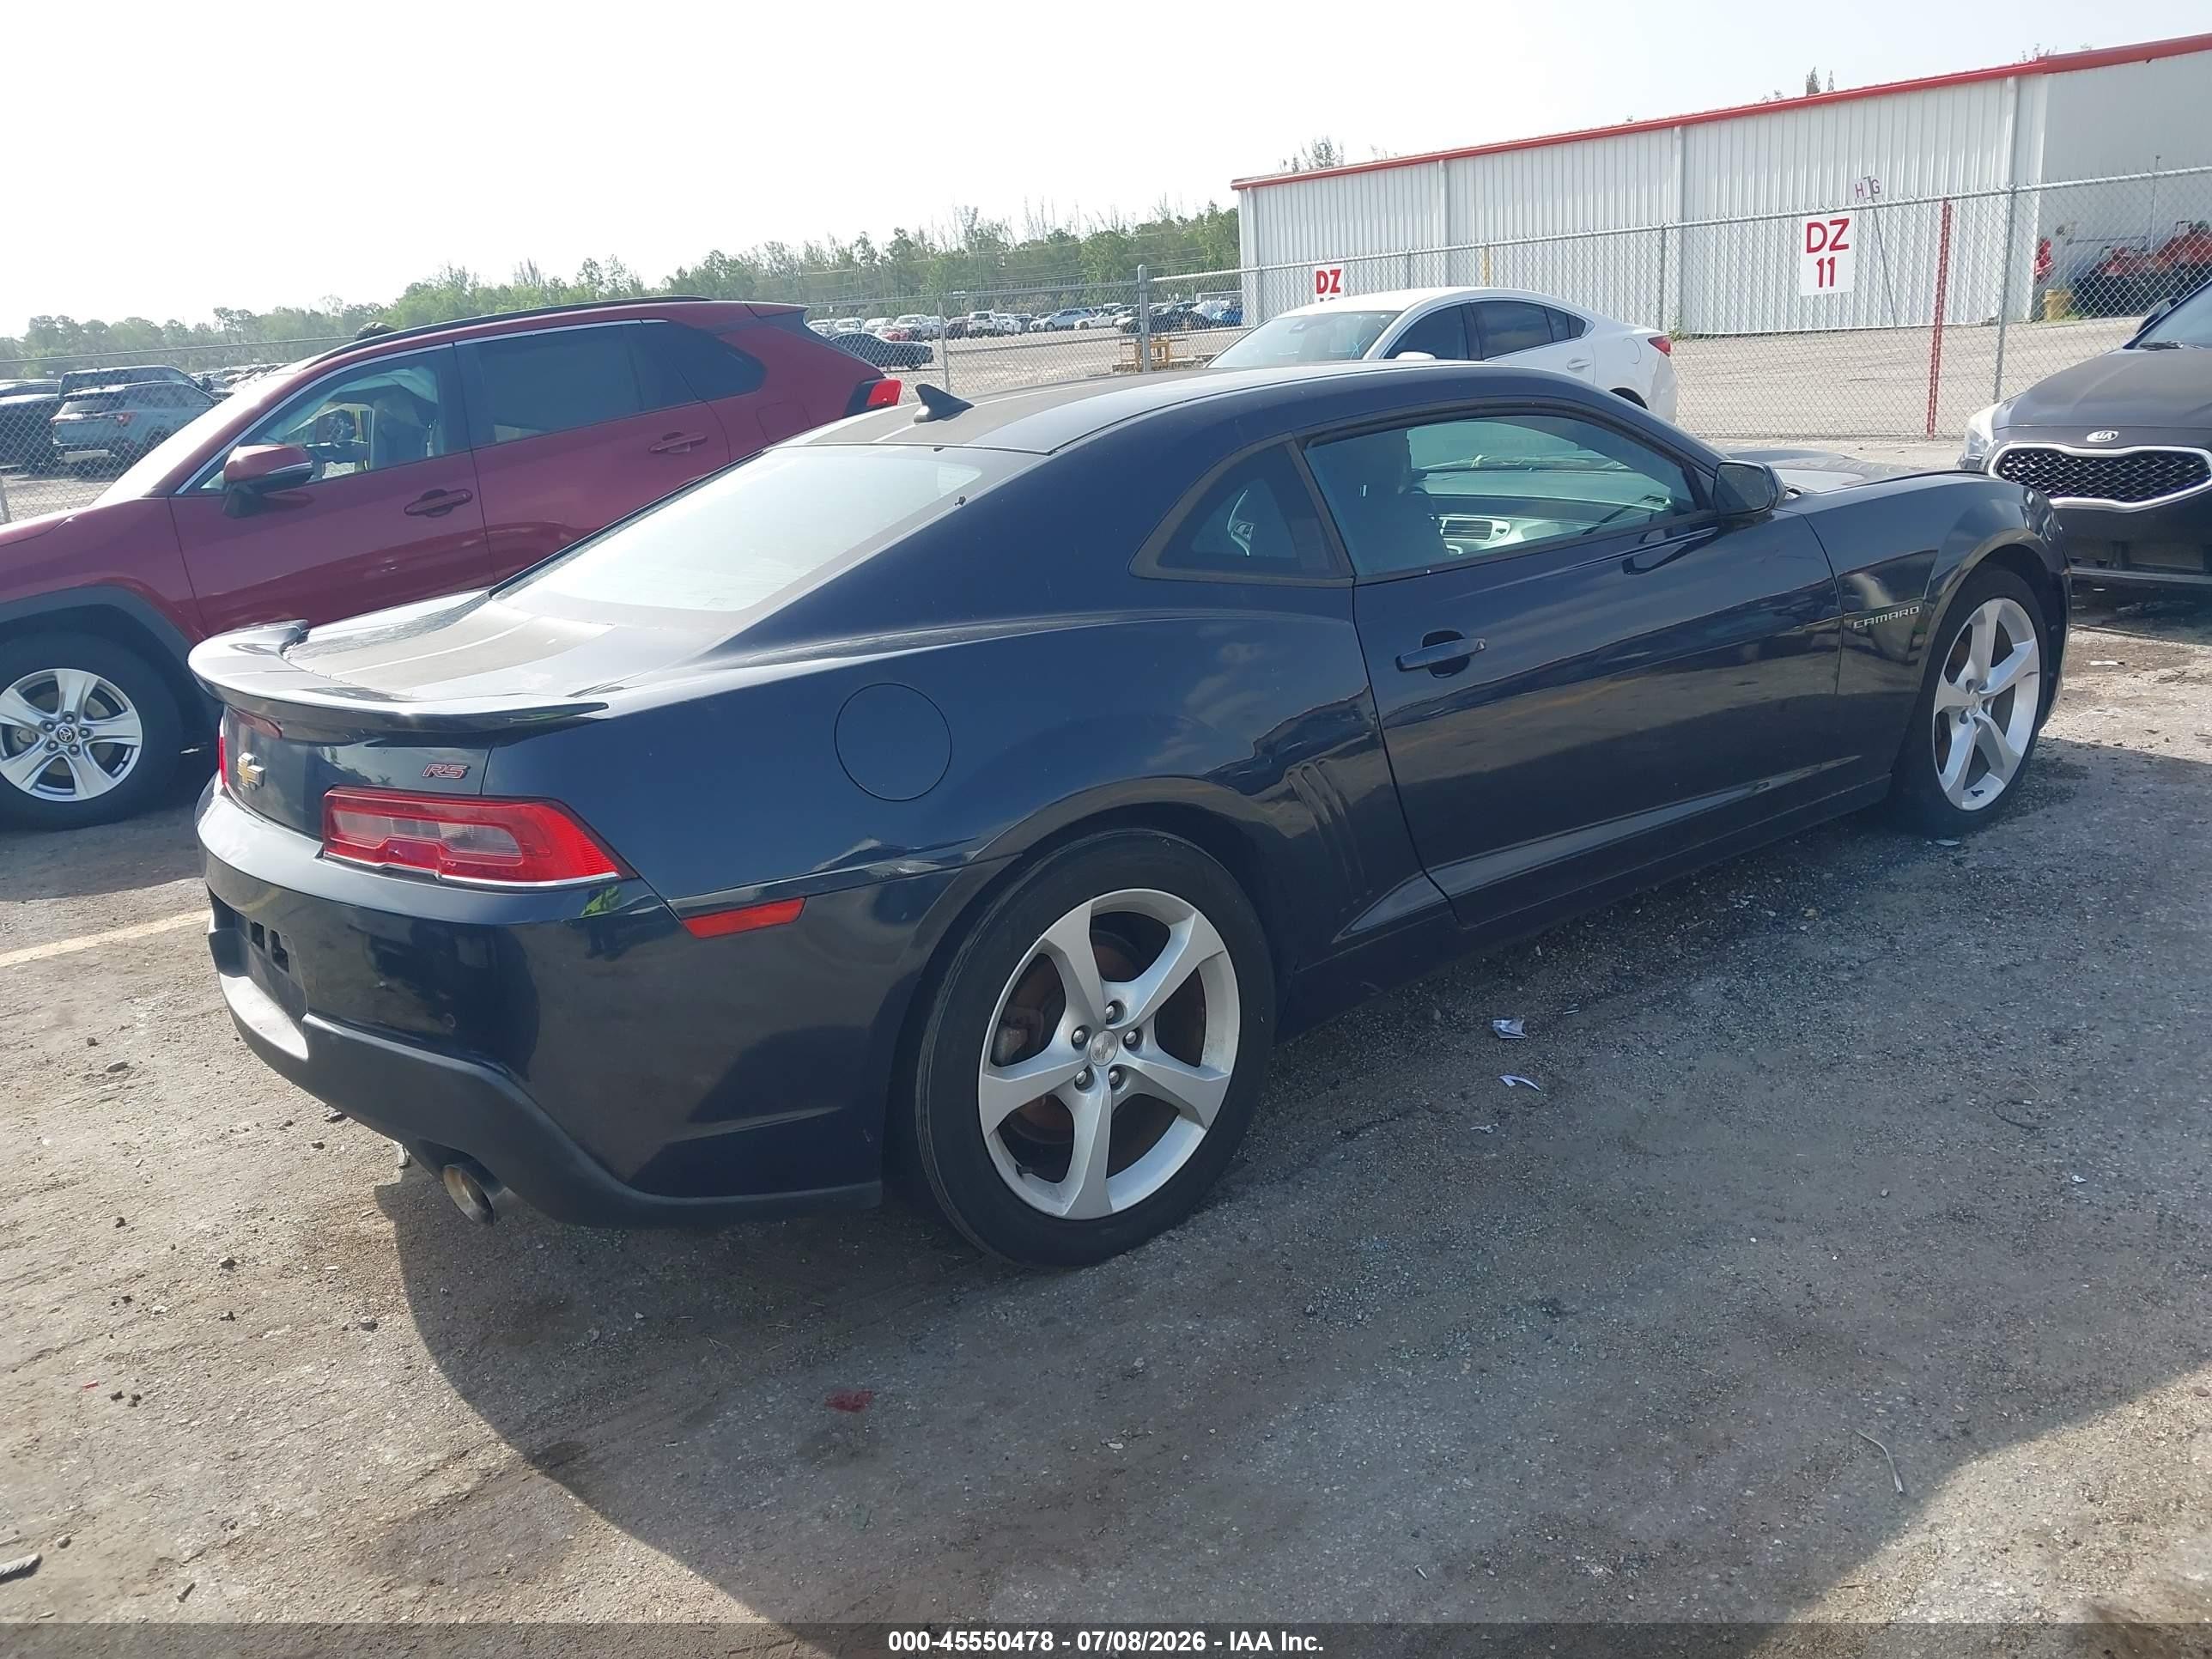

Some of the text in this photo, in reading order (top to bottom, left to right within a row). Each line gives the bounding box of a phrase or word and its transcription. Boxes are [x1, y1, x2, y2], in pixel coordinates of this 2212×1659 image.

[1806, 217, 1850, 253] DZ
[1316, 269, 1341, 294] DZ
[1816, 256, 1835, 288] 11
[1854, 605, 1919, 629] CAMARO
[422, 763, 468, 779] RS
